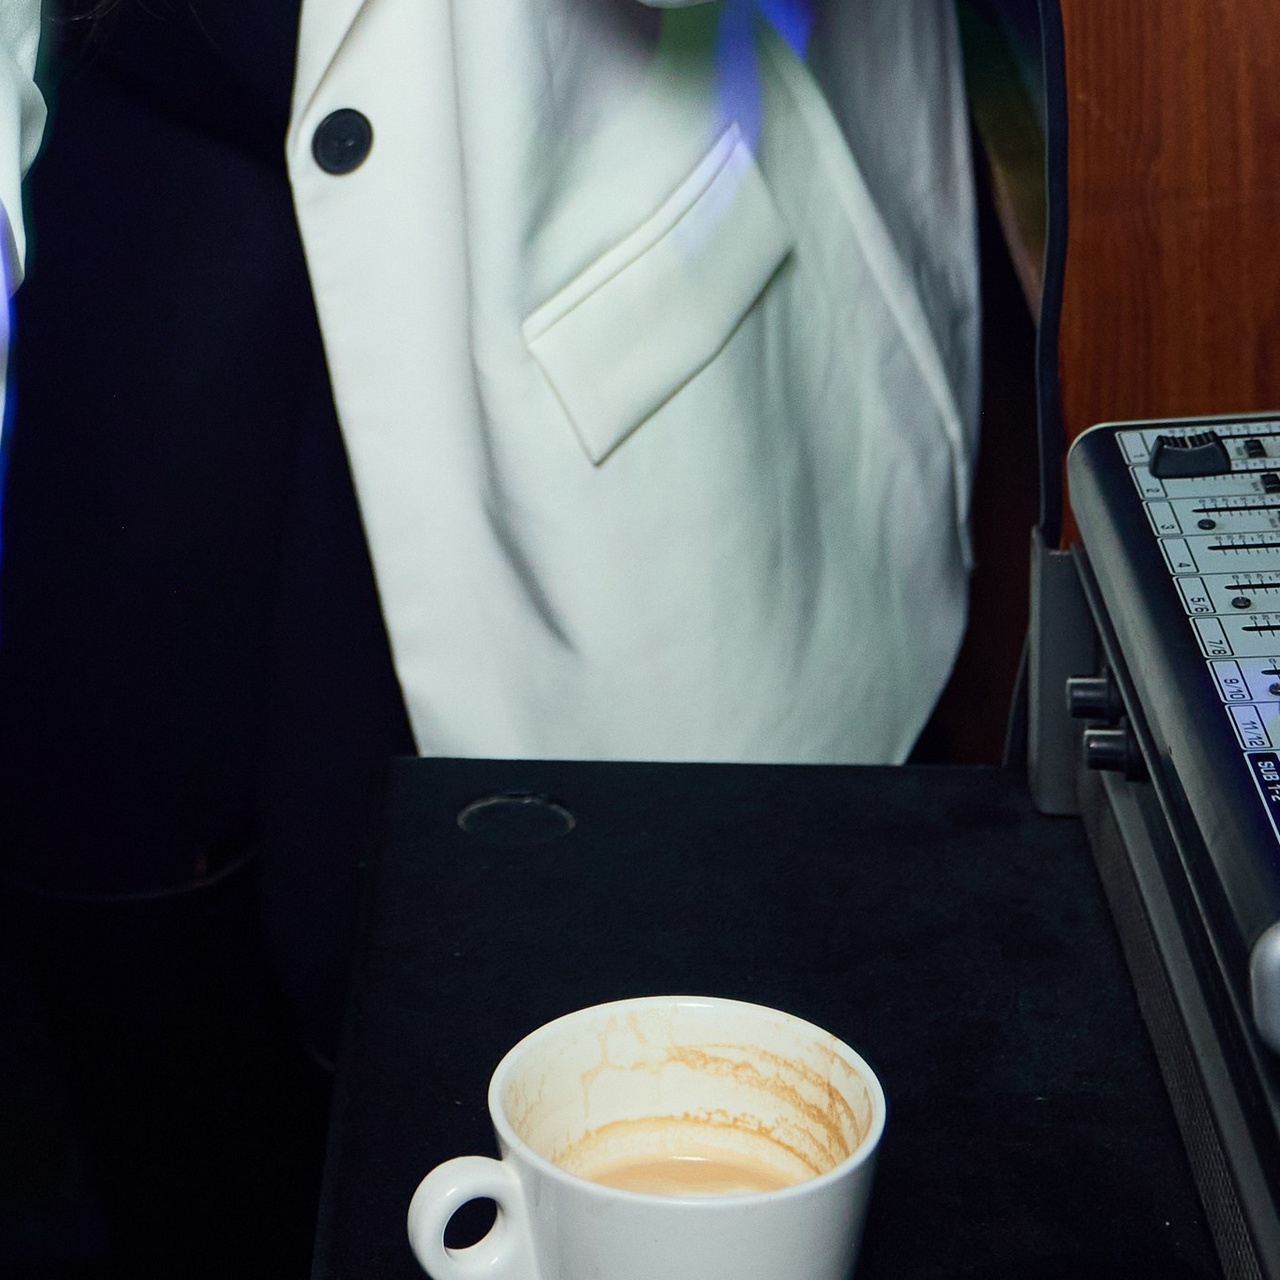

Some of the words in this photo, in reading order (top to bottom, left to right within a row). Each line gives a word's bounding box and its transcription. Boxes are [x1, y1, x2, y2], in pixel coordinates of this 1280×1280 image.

[1190, 597, 1209, 612] 5/6
[1207, 639, 1227, 655] 7/8
[1223, 678, 1245, 700] 9/10
[1241, 720, 1266, 747] 11/12
[1257, 761, 1280, 781] SUB
